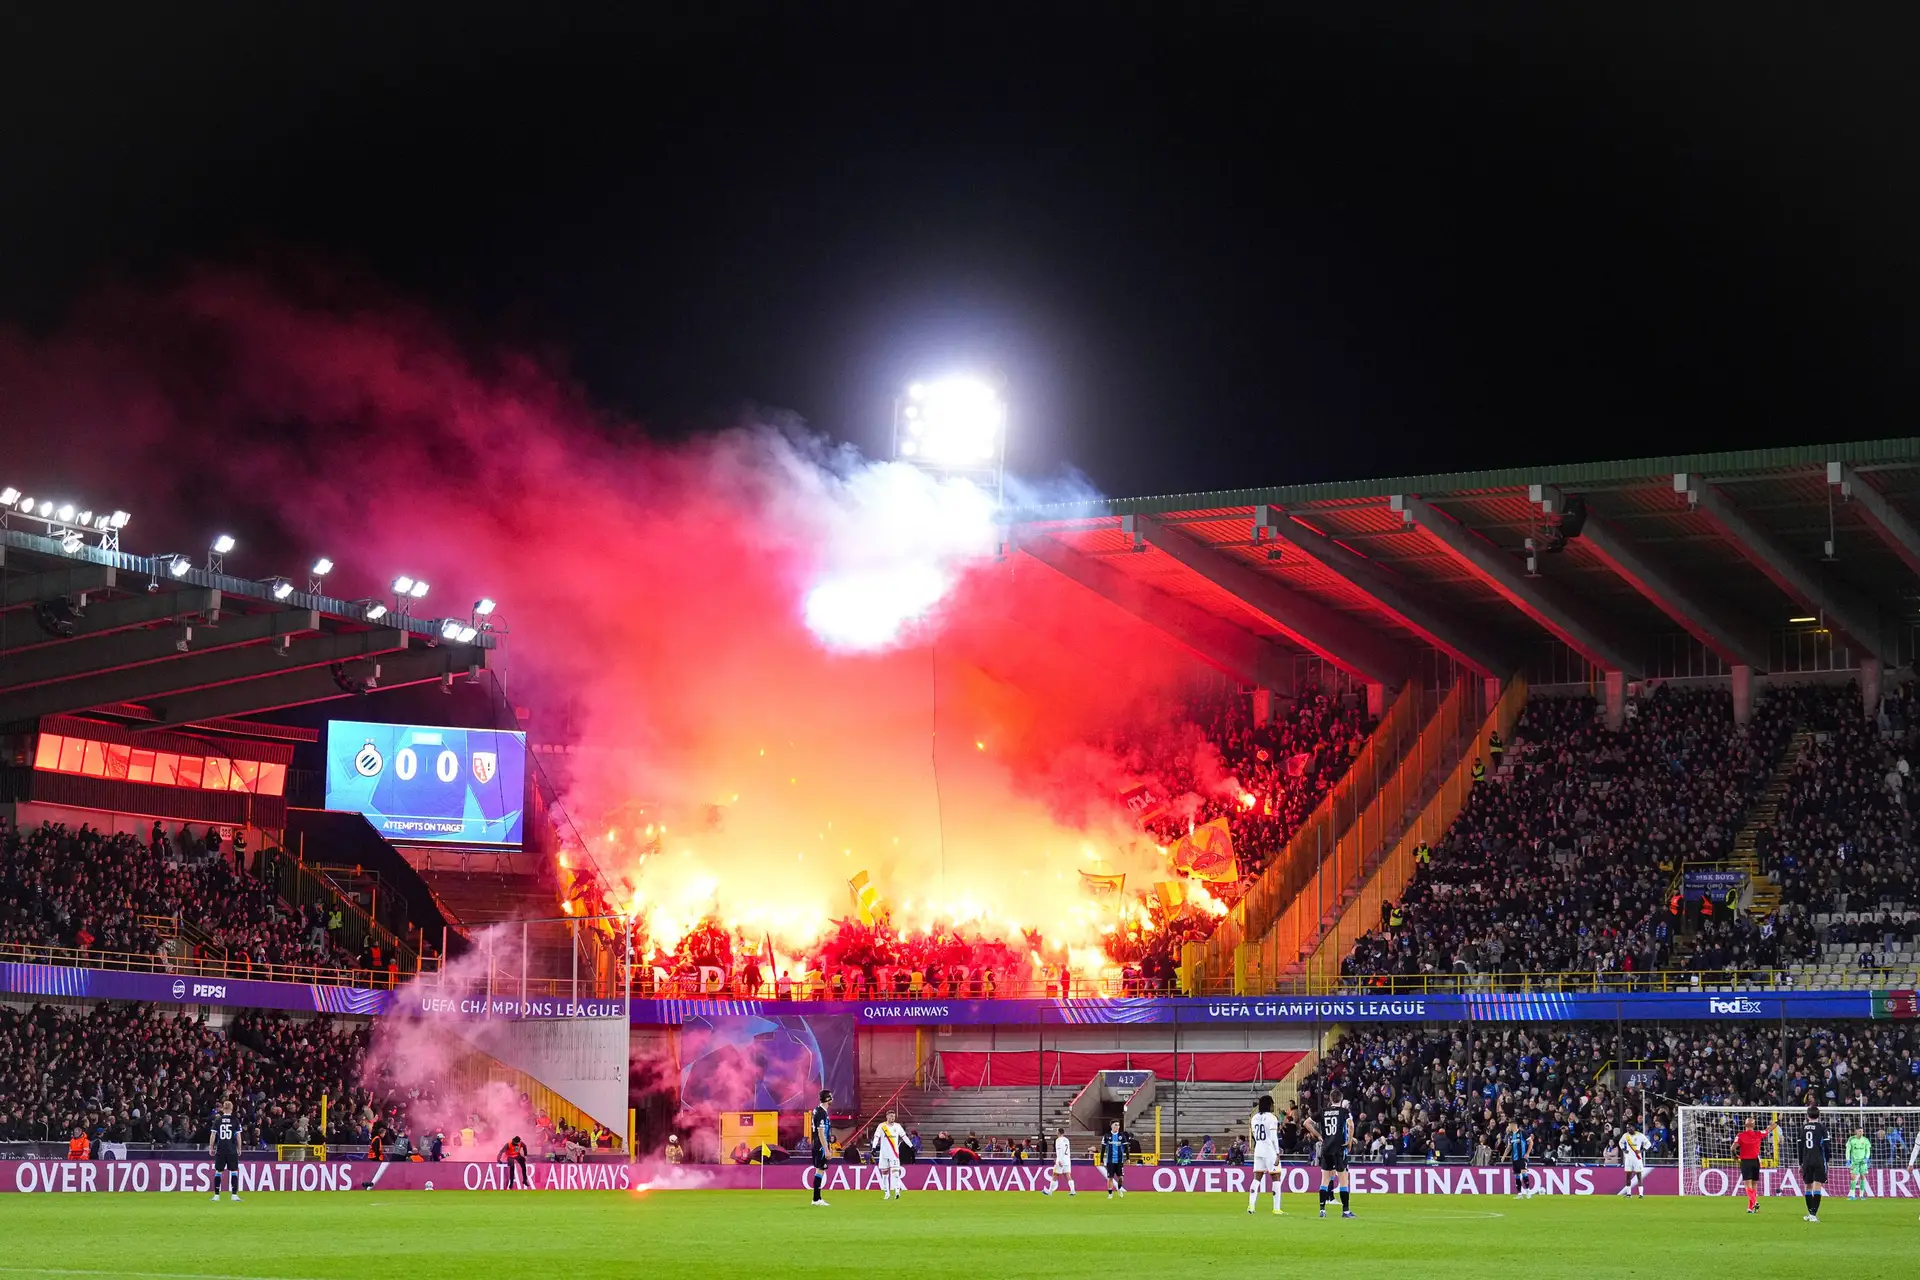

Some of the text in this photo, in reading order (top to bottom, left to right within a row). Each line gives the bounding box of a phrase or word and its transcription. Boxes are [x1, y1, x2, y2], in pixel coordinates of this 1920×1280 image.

[396, 748, 418, 781] 0
[436, 750, 459, 783] 0
[383, 820, 423, 831] ATTEMPTS
[424, 822, 436, 832] ON
[436, 823, 465, 833] TARGET
[193, 984, 227, 999] PEPSI
[421, 998, 621, 1018] UEFA CHAMPIONS LEAGUE
[863, 1006, 950, 1018] QATAR AIRWAYS
[1208, 1000, 1426, 1017] UEFA CHAMPIONS LEAGUE
[1709, 997, 1762, 1014] FedEx
[1629, 1073, 1648, 1083] 413
[219, 1124, 233, 1140] 65
[1254, 1123, 1267, 1141] 28
[1324, 1116, 1338, 1136] 58
[1805, 1131, 1814, 1149] 8
[15, 1162, 352, 1192] OVER 170 DESNATIONS
[545, 1164, 630, 1190] AIRWAYS
[924, 1165, 1059, 1192] AIRWAYS
[1152, 1167, 1245, 1193] OVER
[1333, 1167, 1595, 1196] ESTINATIONS
